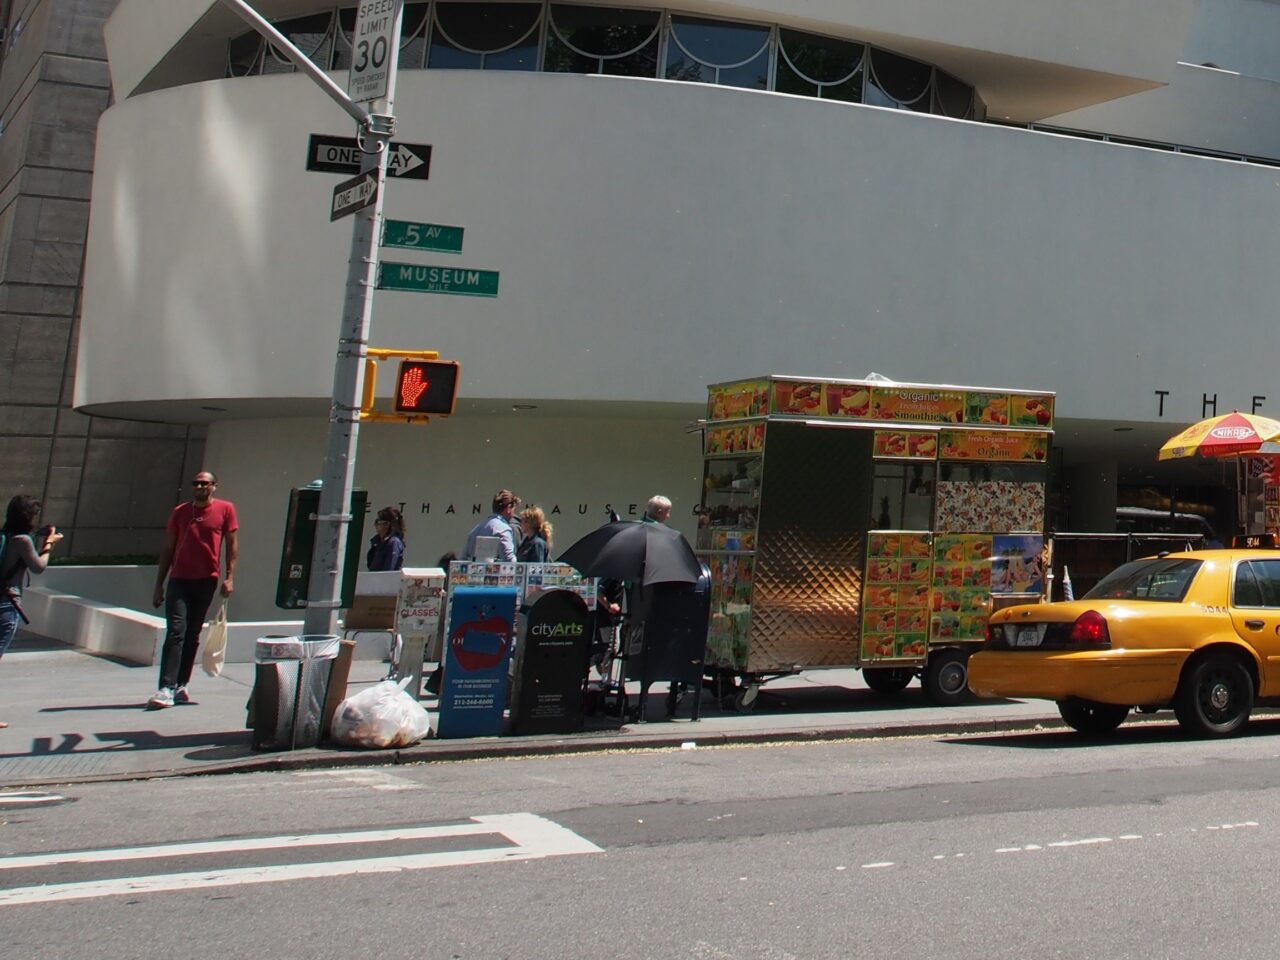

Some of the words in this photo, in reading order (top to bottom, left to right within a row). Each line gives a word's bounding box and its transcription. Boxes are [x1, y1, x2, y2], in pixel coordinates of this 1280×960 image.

[360, 17, 388, 35] LIMIT
[354, 35, 387, 73] 30
[326, 147, 361, 164] ONE
[388, 154, 413, 168] AY
[337, 190, 352, 208] ONE
[359, 180, 374, 198] WAY
[404, 224, 421, 246] 5
[425, 226, 442, 238] AV
[400, 266, 480, 286] MUSEUM
[427, 282, 449, 291] MILE
[899, 390, 939, 403] Organic
[894, 410, 944, 422] Smoothies
[1216, 427, 1246, 438] NIKAS
[400, 607, 439, 618] CLASSES
[531, 622, 584, 637] cityArts
